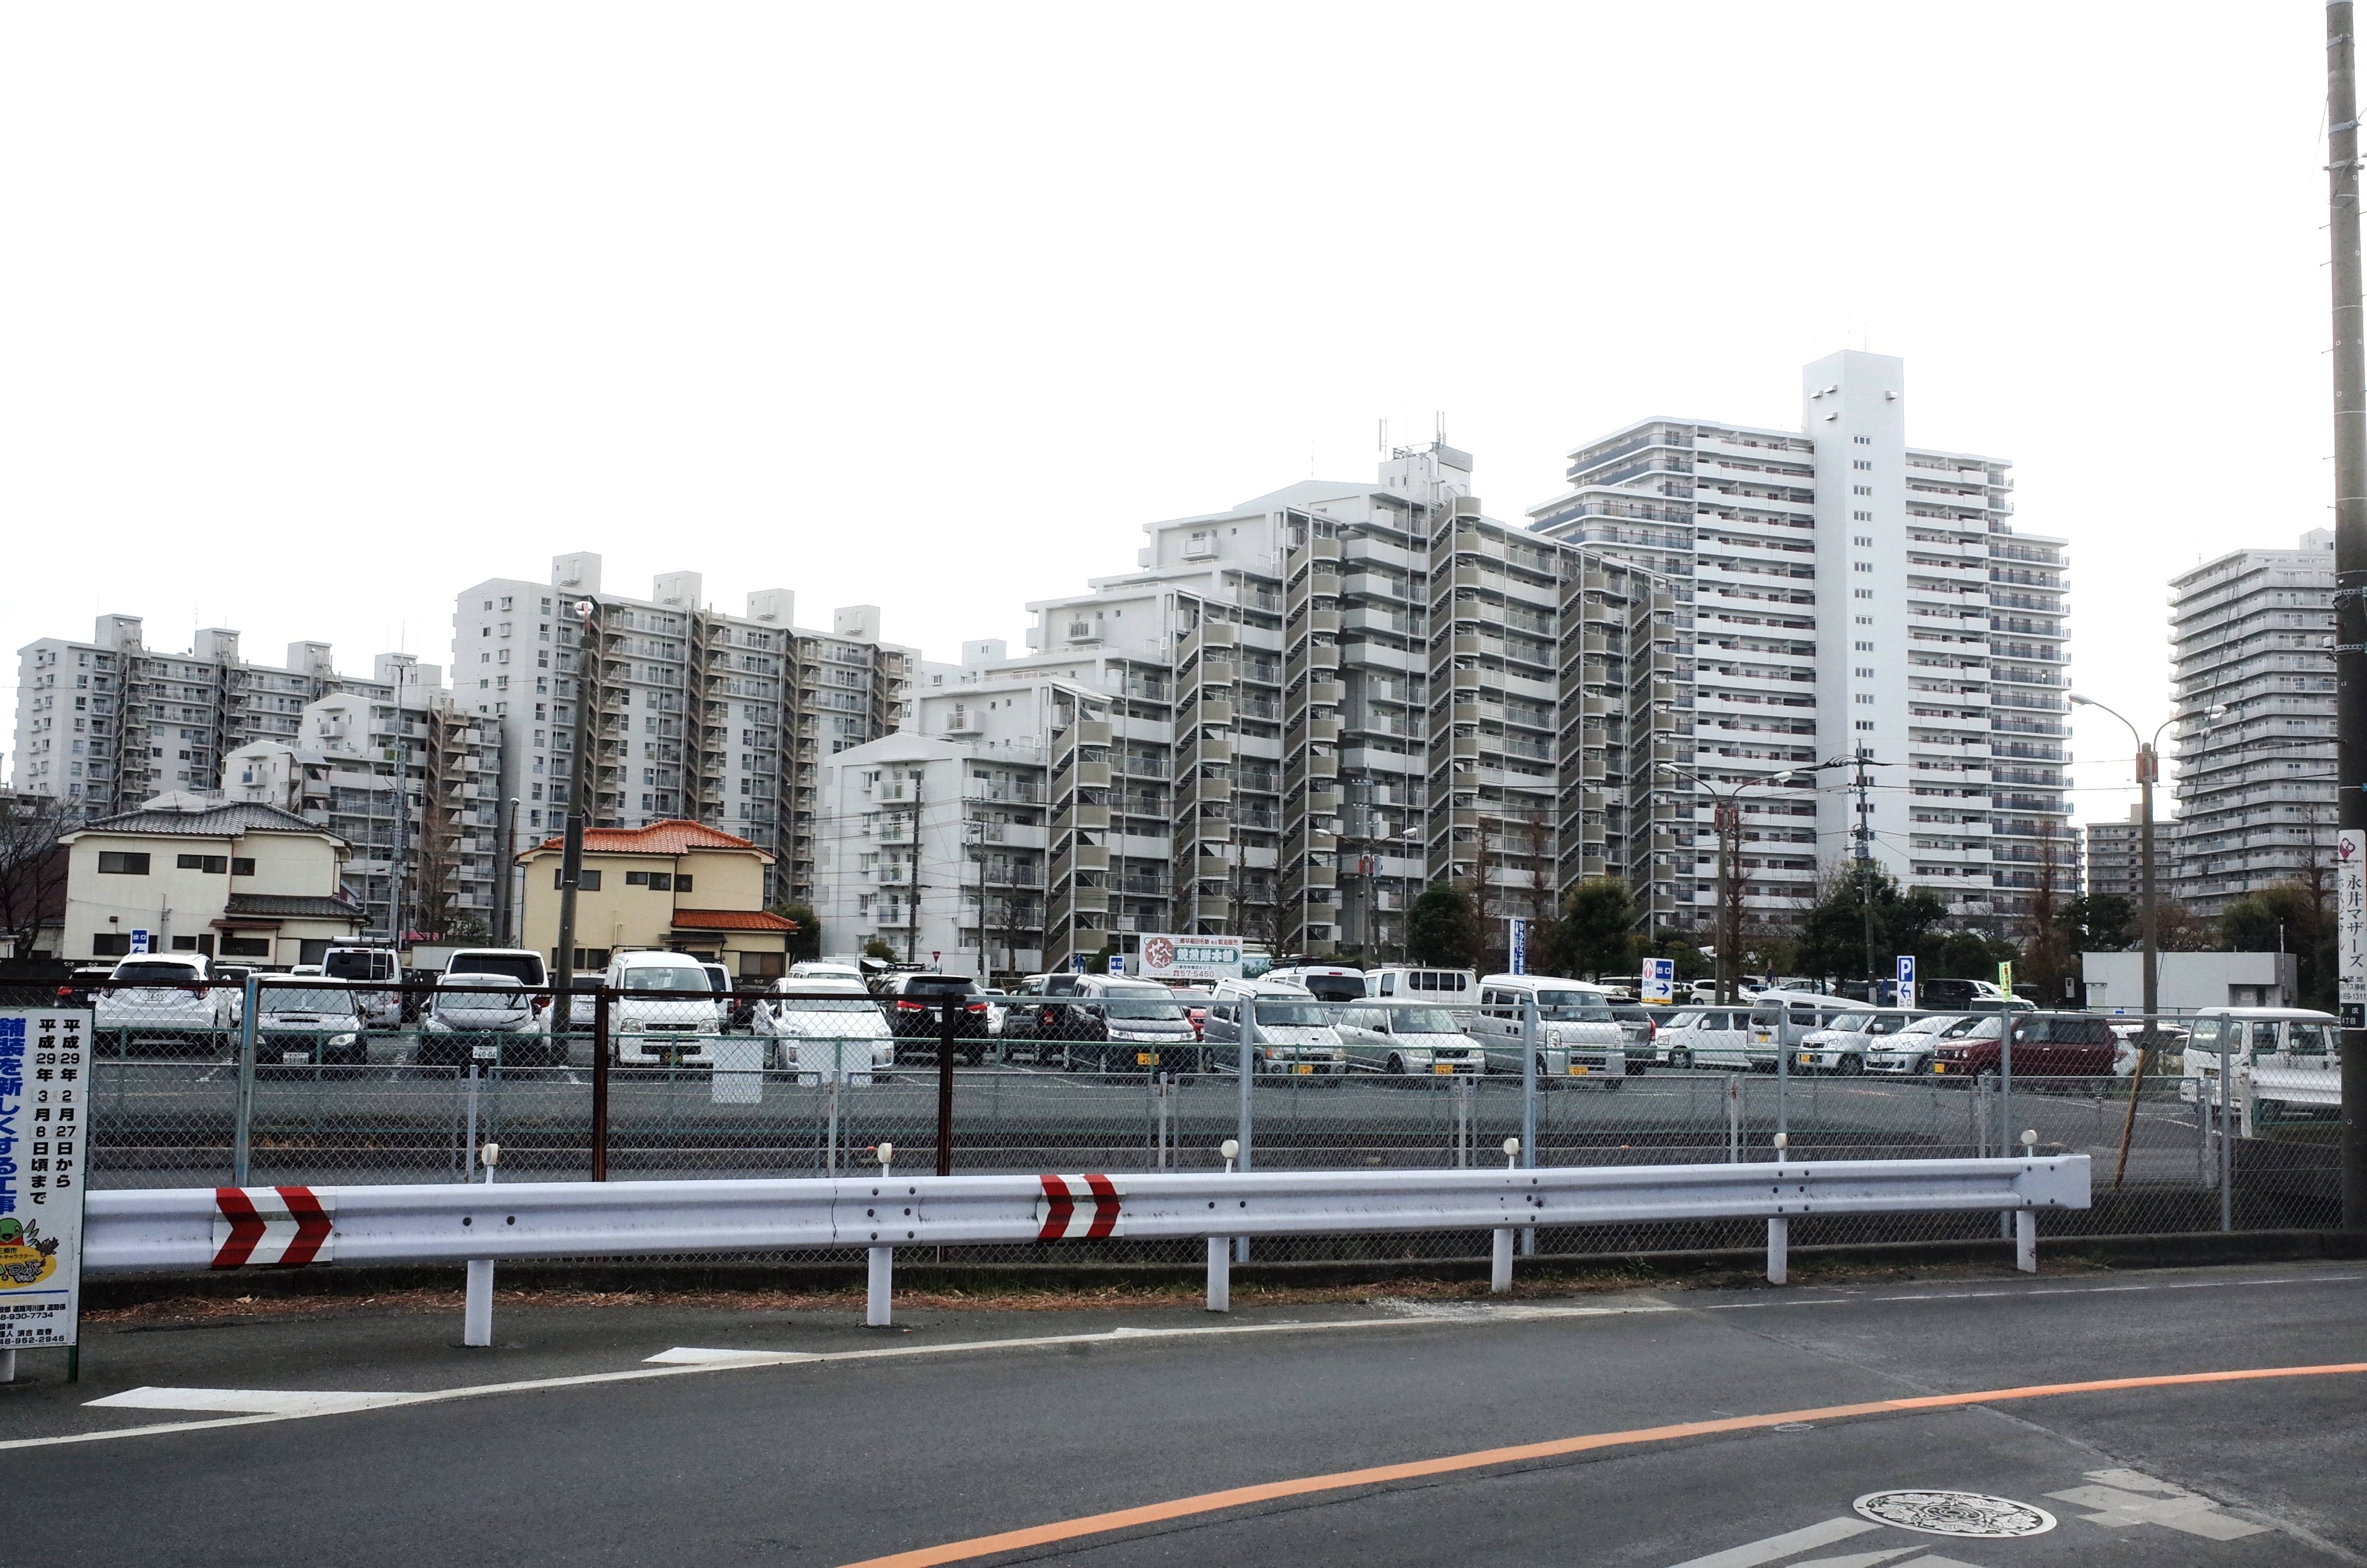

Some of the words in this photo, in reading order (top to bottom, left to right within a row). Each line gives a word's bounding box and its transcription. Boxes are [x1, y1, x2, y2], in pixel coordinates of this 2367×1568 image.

[2347, 874, 2364, 968] 永井マザーズ
[1656, 966, 1671, 975] 出口
[1900, 959, 1911, 981] P
